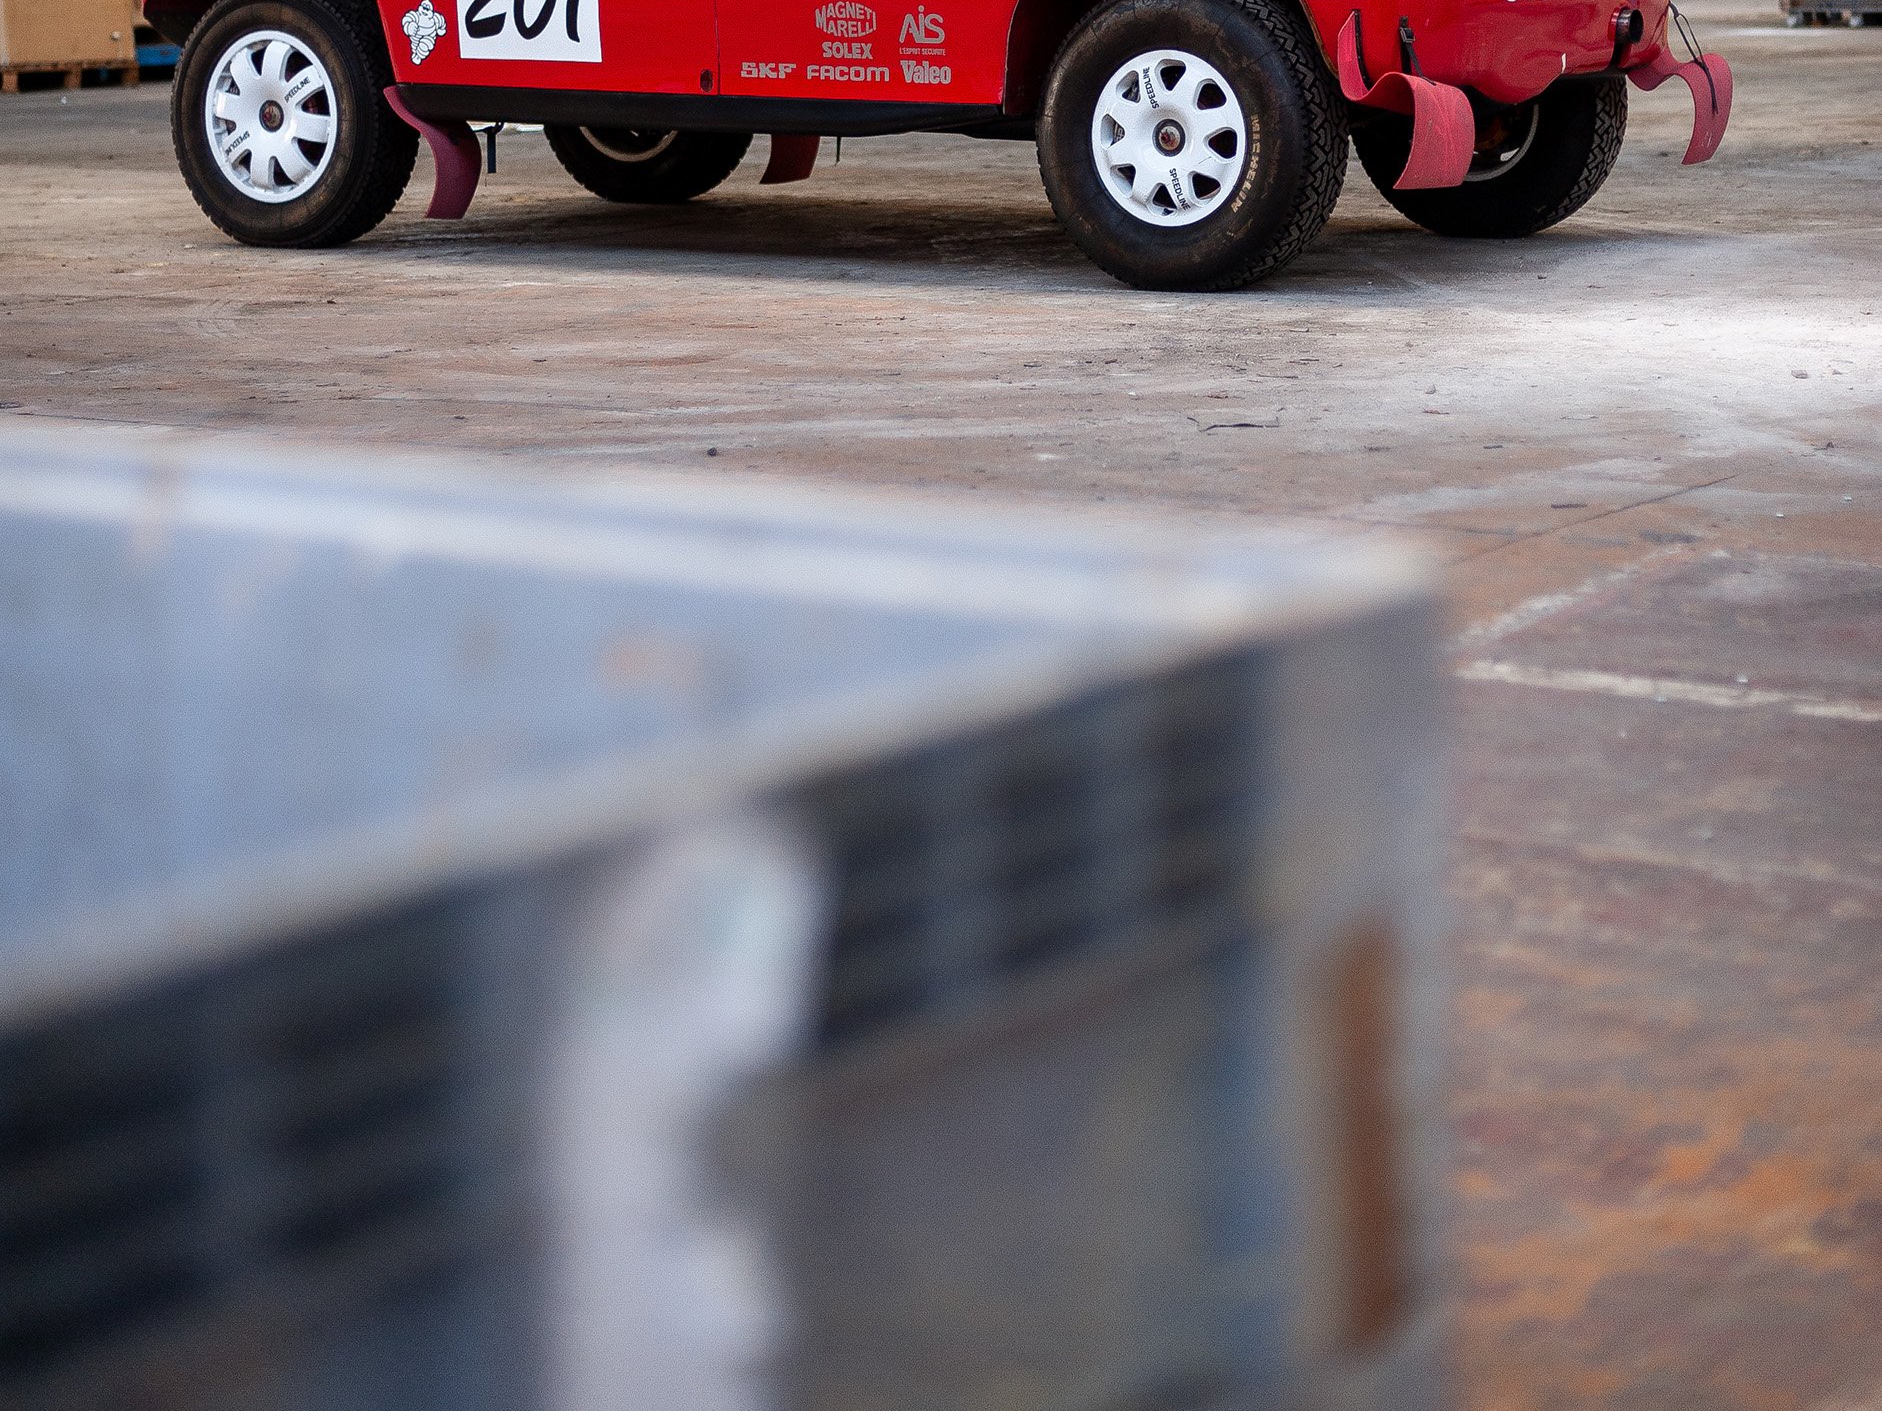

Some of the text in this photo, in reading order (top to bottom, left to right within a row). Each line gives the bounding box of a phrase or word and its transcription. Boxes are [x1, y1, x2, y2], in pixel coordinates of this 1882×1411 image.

[822, 41, 873, 60] SOLEX
[741, 62, 796, 79] SKF
[900, 59, 952, 84] Valeo
[1142, 66, 1160, 109] SPEEDLINE
[1169, 168, 1191, 211] SPEEDLINE
